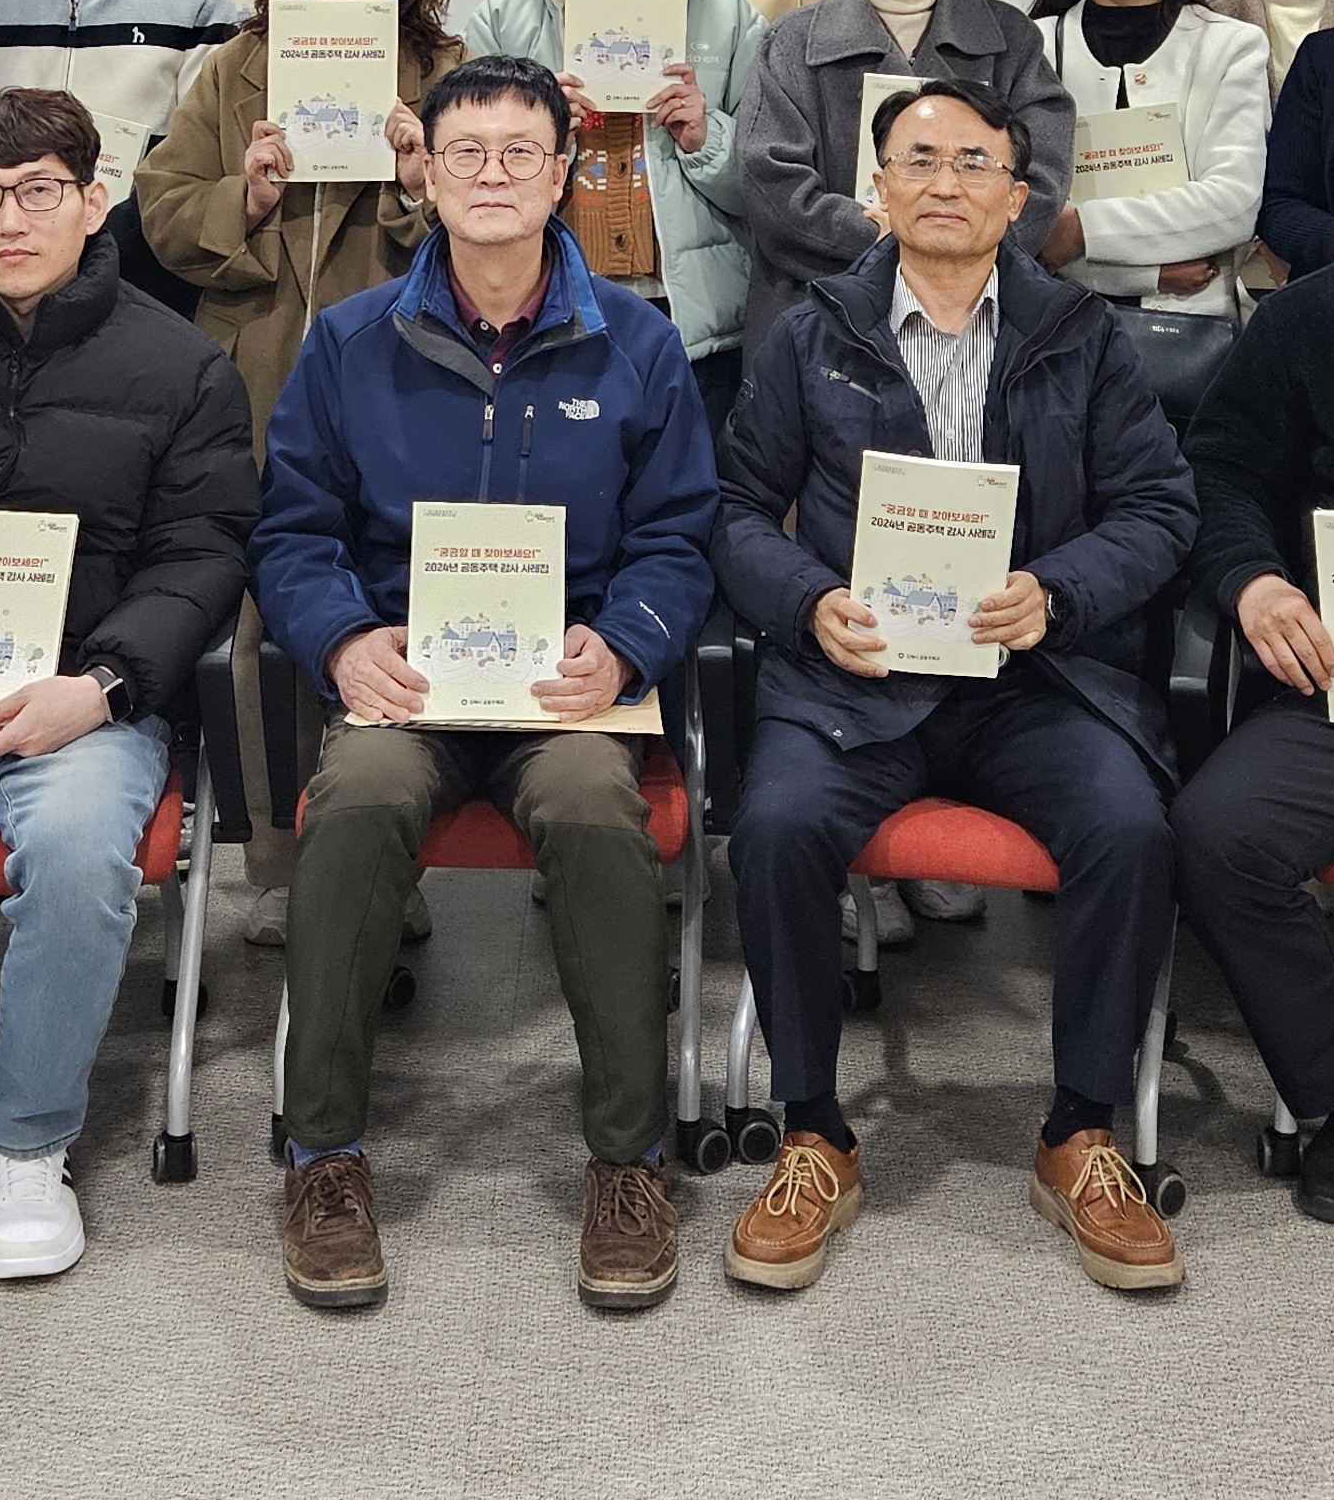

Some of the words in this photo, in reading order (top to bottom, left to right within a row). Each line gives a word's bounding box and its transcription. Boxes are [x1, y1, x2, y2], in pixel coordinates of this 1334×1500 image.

[870, 516, 904, 530] 2024년
[906, 521, 944, 535] 공동주택
[424, 561, 458, 572] 2024년
[460, 562, 498, 572] 공동주택
